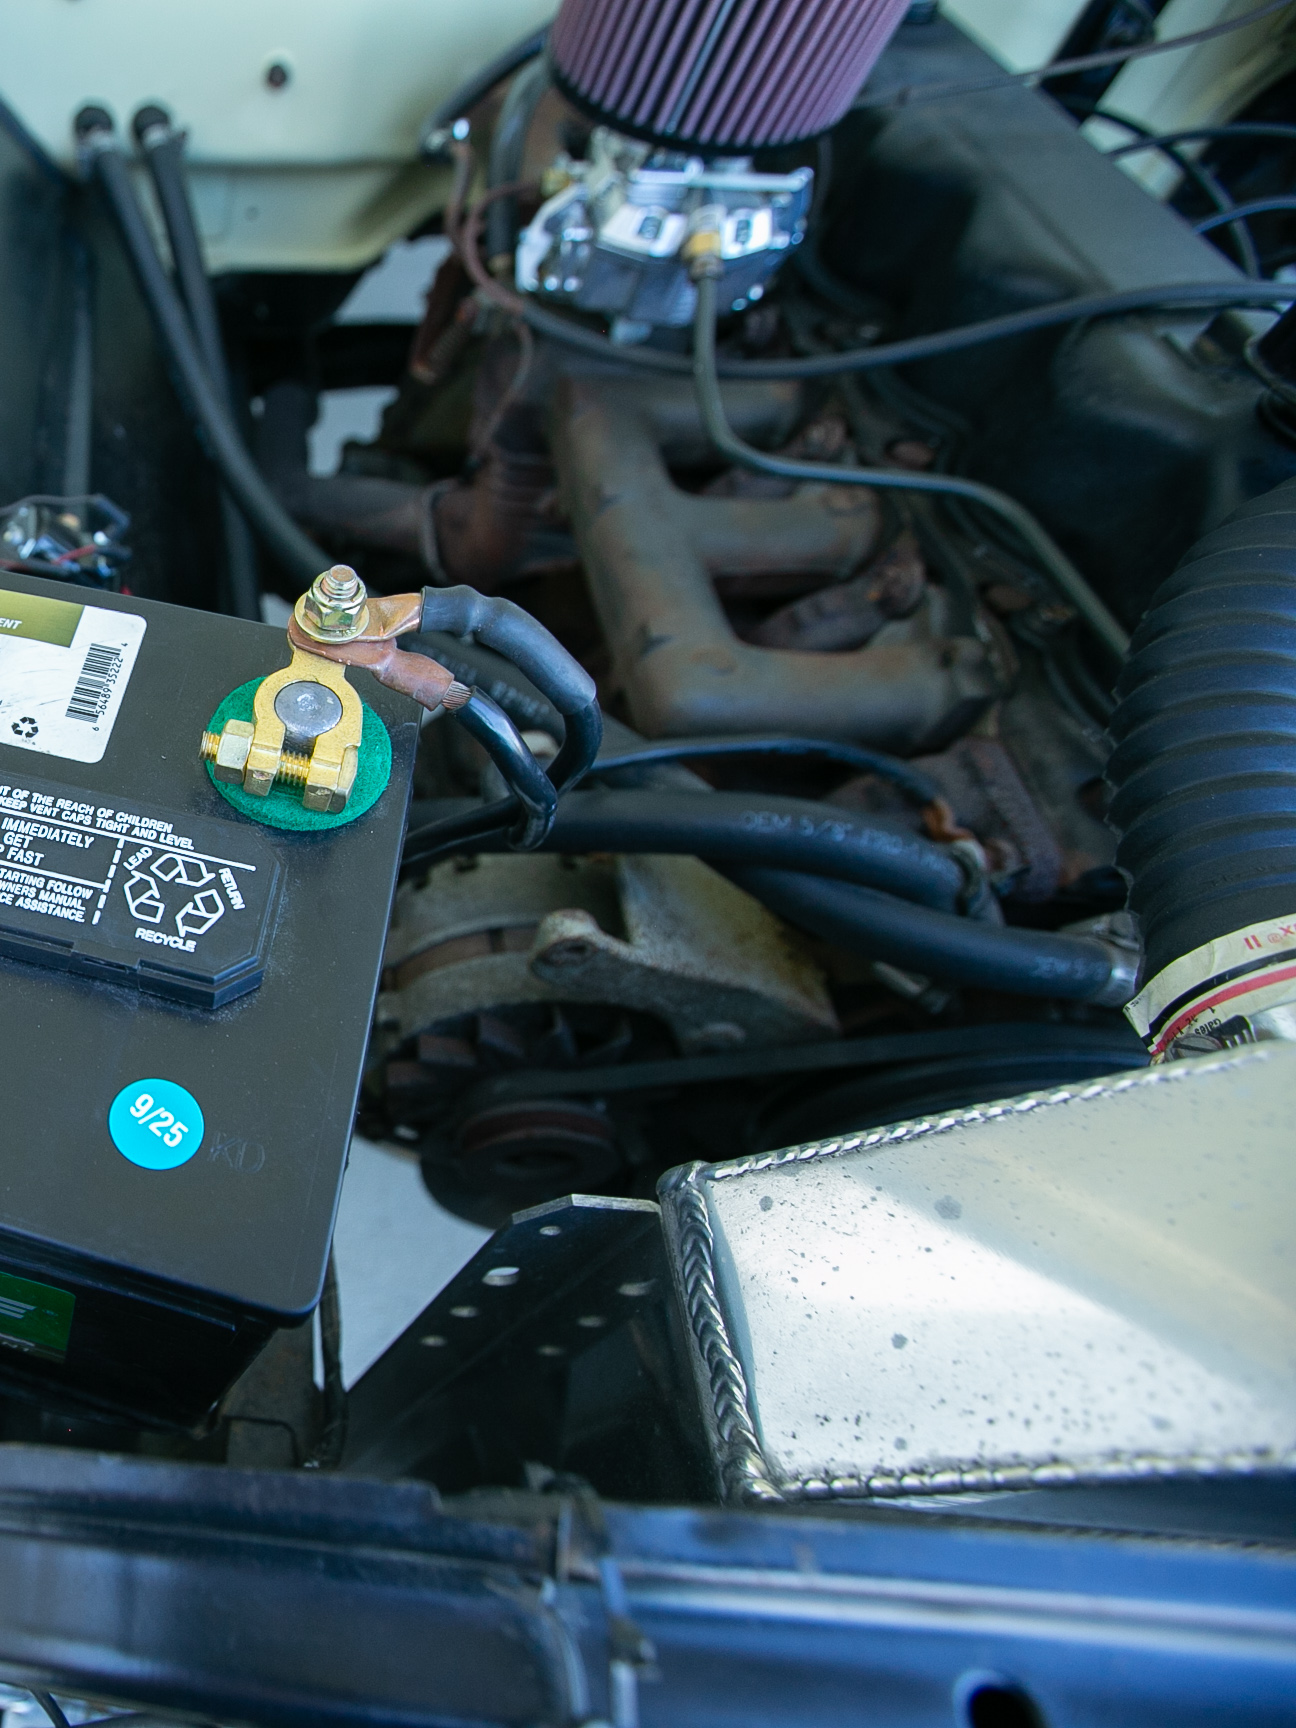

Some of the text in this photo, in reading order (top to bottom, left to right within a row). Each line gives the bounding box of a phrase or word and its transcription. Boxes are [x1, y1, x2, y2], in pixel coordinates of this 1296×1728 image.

[96, 688, 112, 716] 56489
[106, 657, 124, 684] 35222
[12, 788, 30, 800] OF
[32, 792, 54, 806] THE
[56, 798, 94, 816] REACH
[97, 808, 114, 818] OF
[116, 812, 174, 834] CHILDREN
[1, 817, 94, 848] IMMEDIATELY
[4, 831, 34, 848] GET
[30, 803, 60, 818] VENT
[61, 811, 92, 826] CAPS
[96, 818, 130, 834] TIGHT
[131, 828, 157, 840] AND
[159, 834, 194, 850] LEVEL
[6, 847, 44, 866] FAST
[122, 846, 153, 870] LEAD
[46, 880, 94, 900] FOLLOW
[218, 868, 246, 910] RETURN
[14, 897, 86, 922] ASSISTANCE.
[134, 927, 197, 952] RECYCLE
[130, 1094, 189, 1148] 9/25
